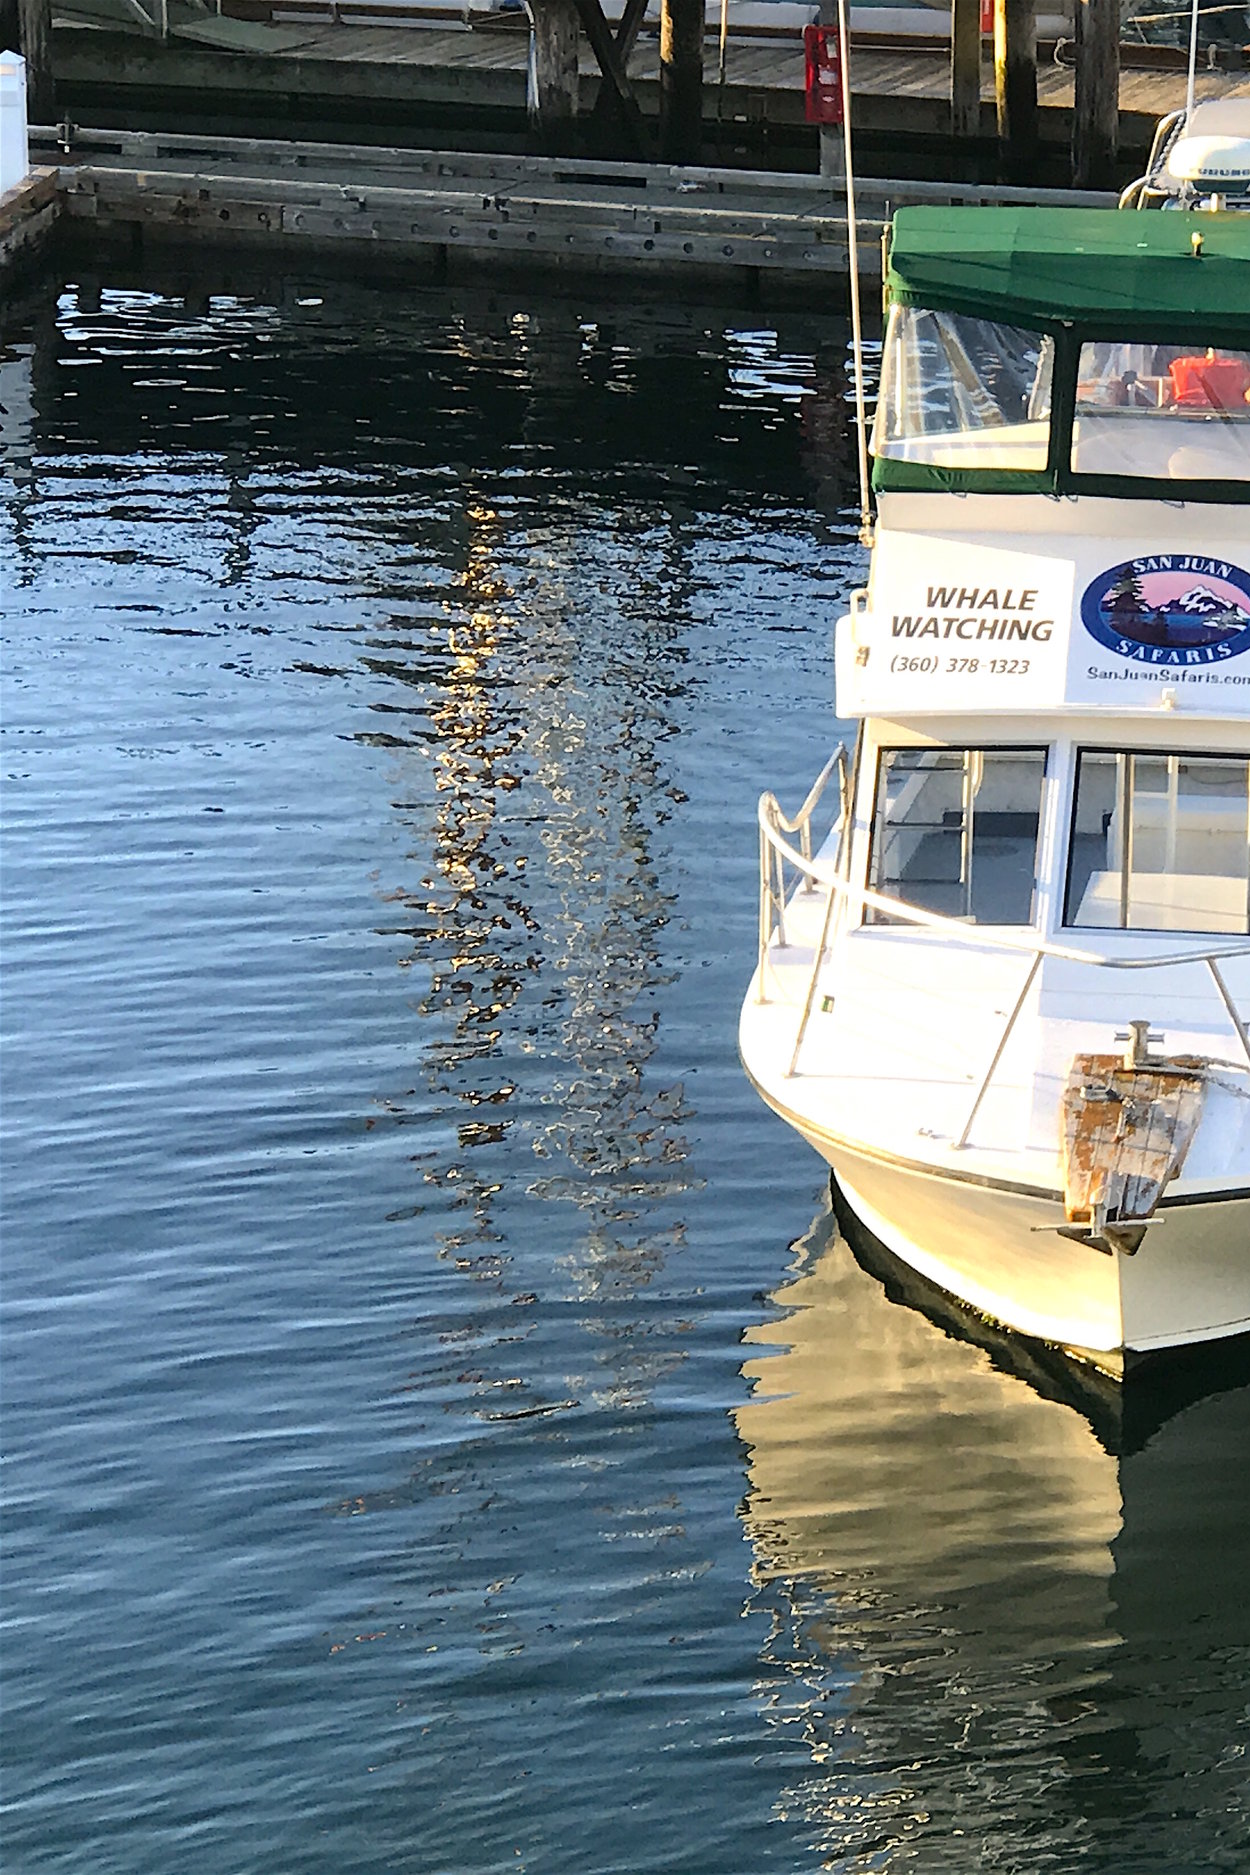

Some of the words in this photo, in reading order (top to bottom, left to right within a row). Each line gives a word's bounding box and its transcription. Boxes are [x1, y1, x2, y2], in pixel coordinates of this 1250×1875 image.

[1132, 556, 1173, 574] SAN
[1179, 557, 1233, 579] JUAN
[926, 586, 1039, 611] WHALE
[891, 615, 1054, 641] WATCHING
[1116, 640, 1232, 664] SAFARIS
[890, 655, 939, 674] (360)
[946, 658, 1031, 674] 378-1323
